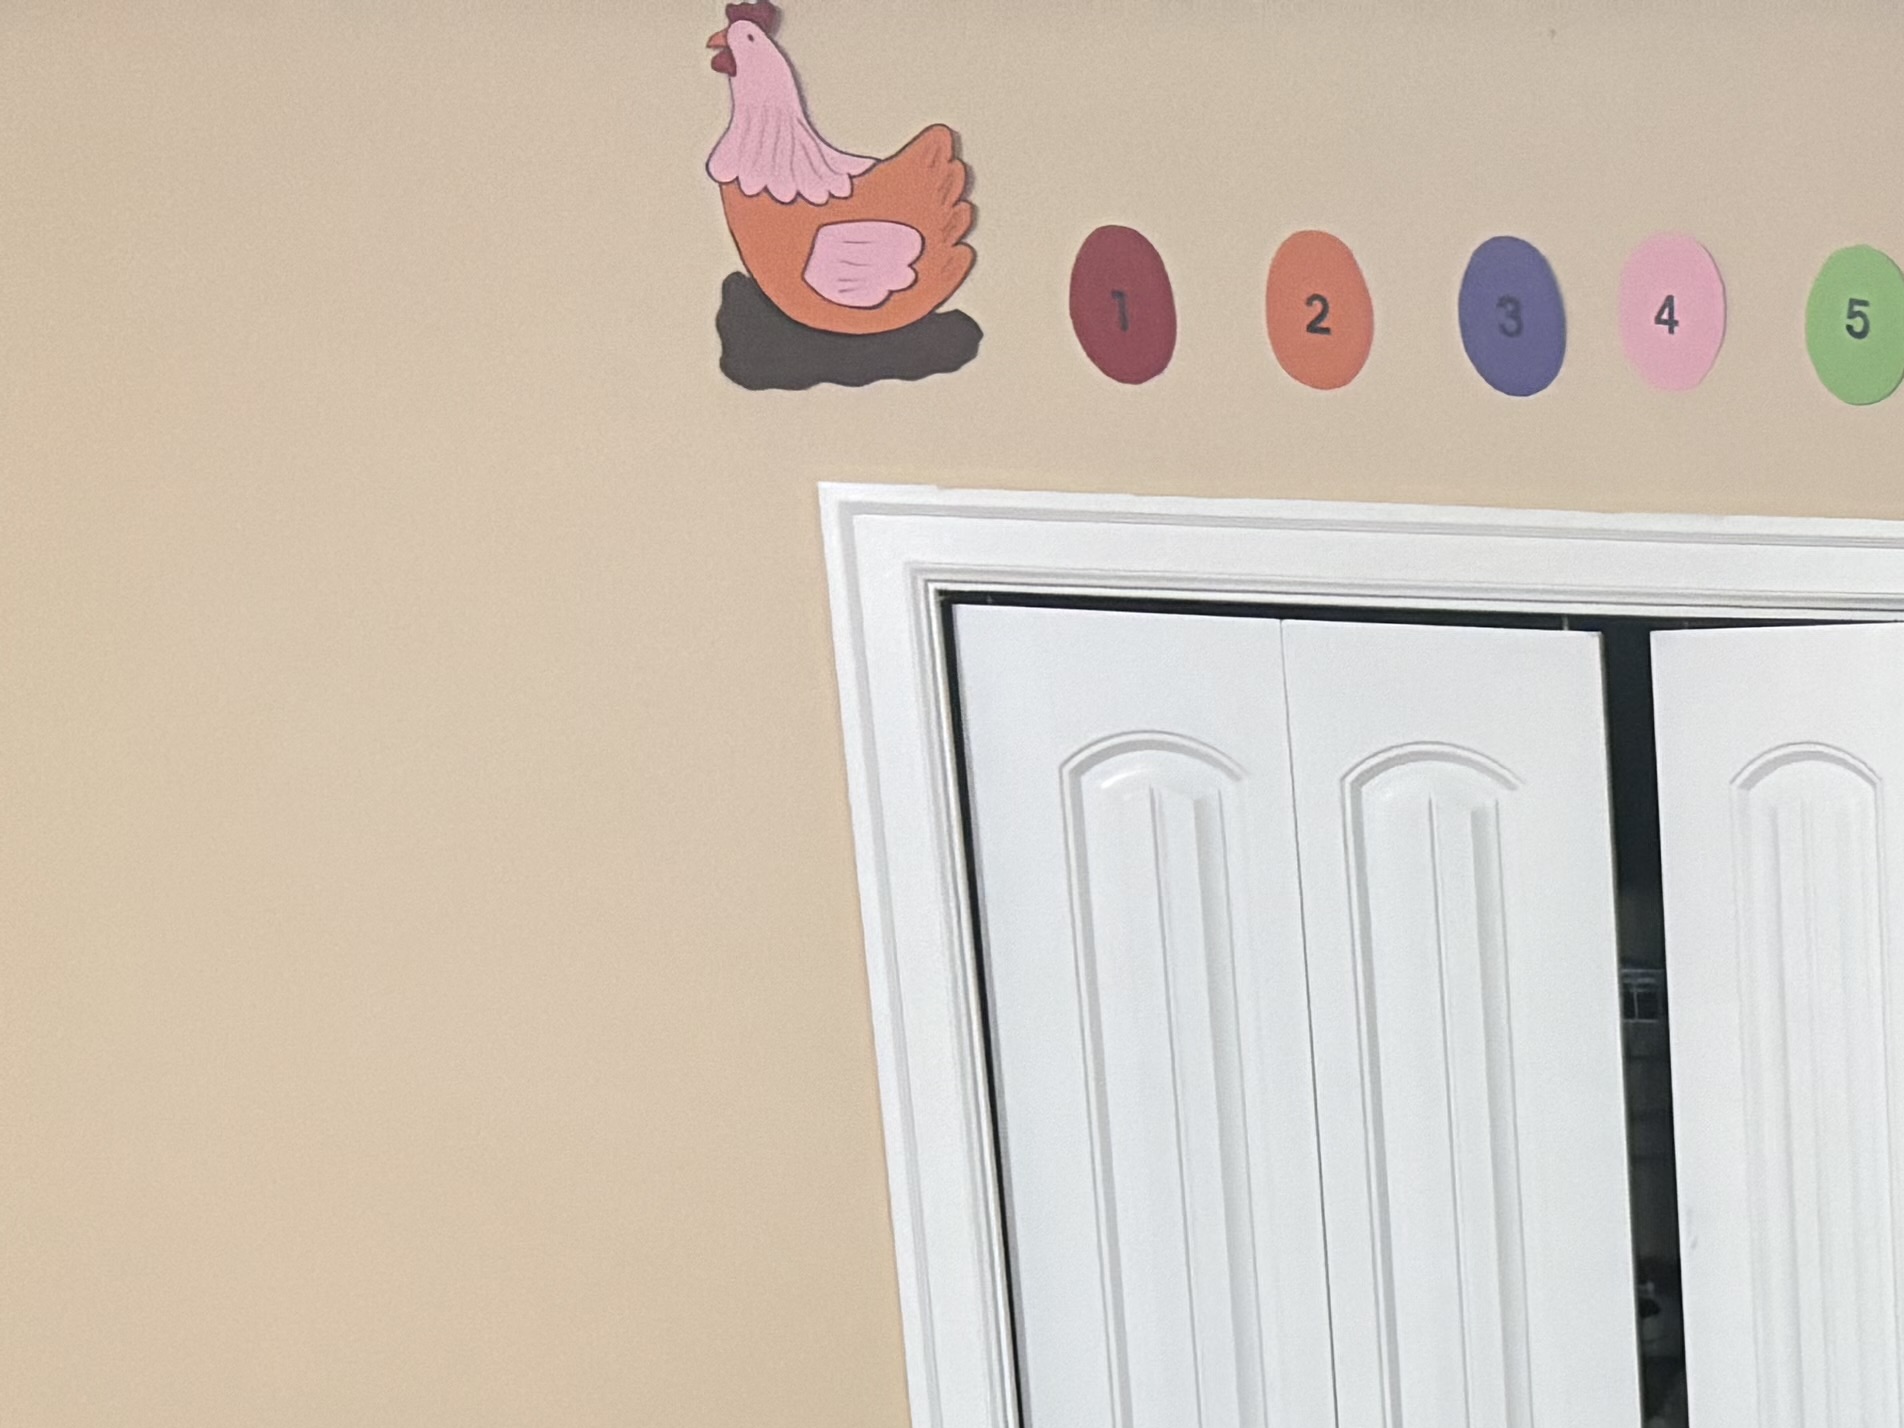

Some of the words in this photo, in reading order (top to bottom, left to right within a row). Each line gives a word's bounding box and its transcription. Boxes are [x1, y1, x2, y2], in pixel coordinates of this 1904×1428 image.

[1111, 289, 1129, 332] 1
[1306, 294, 1331, 335] 2
[1496, 295, 1523, 337] 3
[1654, 295, 1679, 335] 4
[1845, 298, 1871, 339] 5
